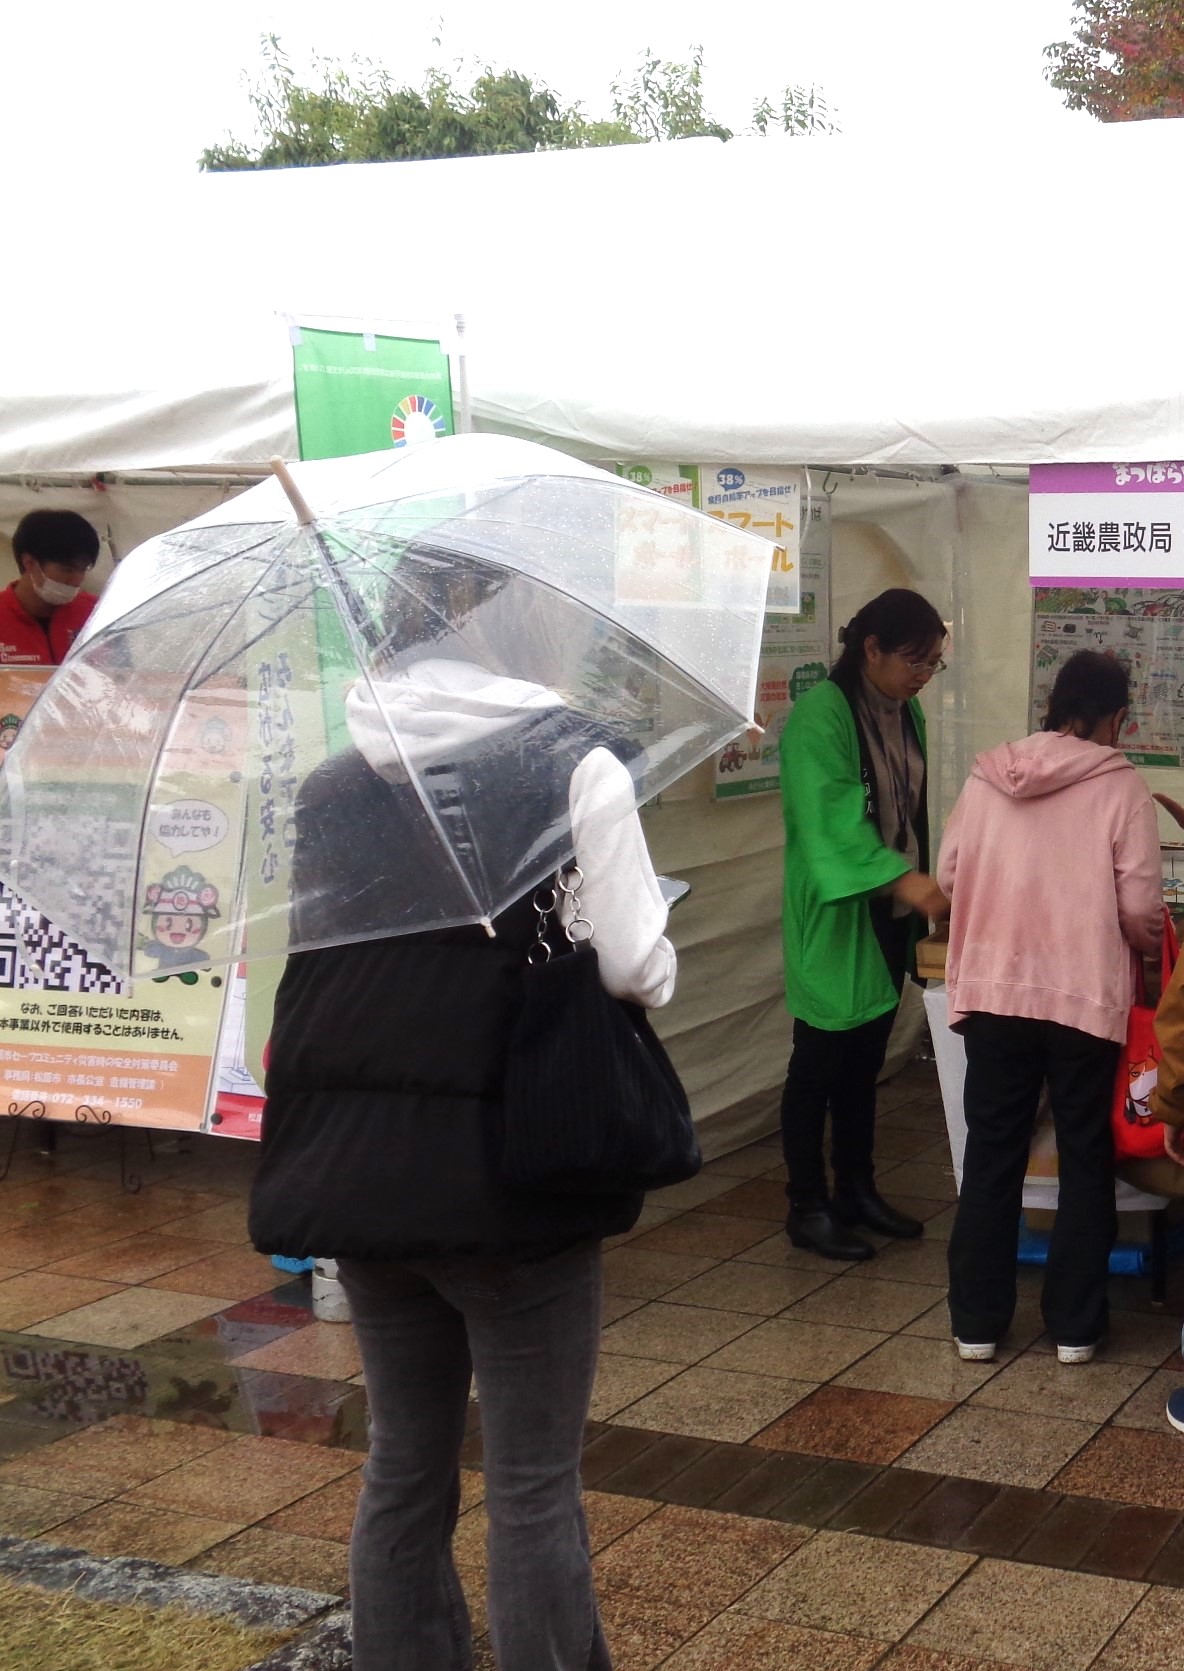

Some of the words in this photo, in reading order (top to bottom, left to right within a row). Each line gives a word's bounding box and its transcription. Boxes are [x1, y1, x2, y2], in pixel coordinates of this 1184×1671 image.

[718, 472, 744, 485] 38%
[1047, 521, 1172, 554] 近畿農政局
[20, 1002, 165, 1023] なお、ご回答いただいた内容は、
[0, 1019, 184, 1042] 本事業以外で使用することはありません。
